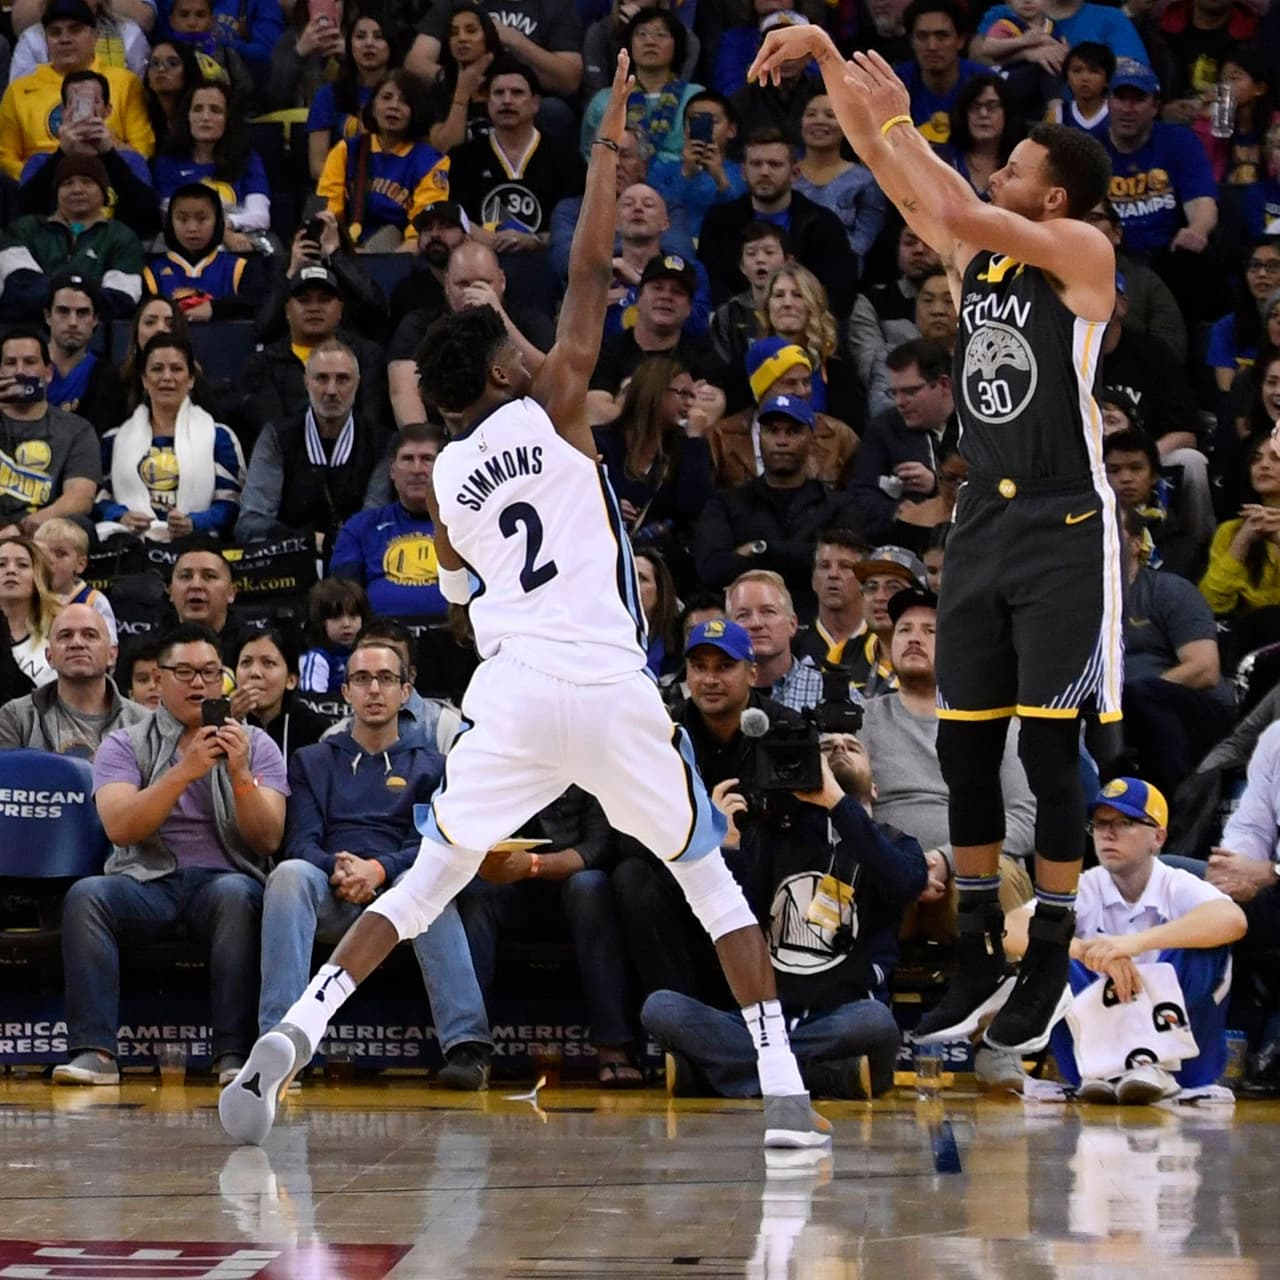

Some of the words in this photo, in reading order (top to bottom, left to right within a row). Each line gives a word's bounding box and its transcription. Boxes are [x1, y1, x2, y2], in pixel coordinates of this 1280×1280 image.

[507, 193, 535, 216] 30
[962, 293, 1032, 334] TOWN
[977, 379, 1013, 415] 30
[456, 445, 543, 512] SIMMONS
[498, 501, 559, 594] 2
[117, 1024, 213, 1040] AMERI
[324, 1024, 438, 1040] MERICAN
[315, 1041, 420, 1057] XPRESS
[490, 1041, 598, 1057] XPRESS
